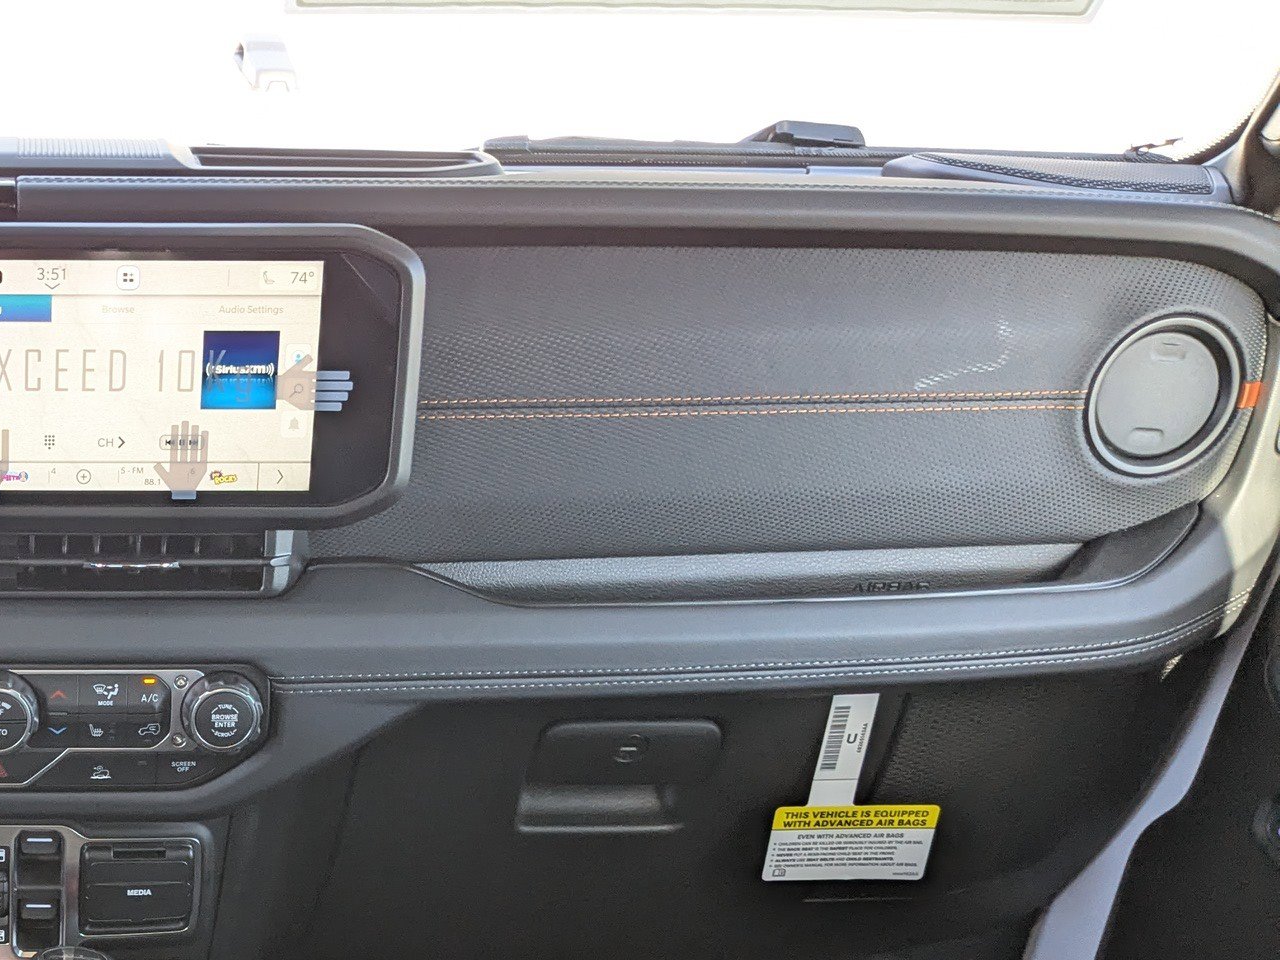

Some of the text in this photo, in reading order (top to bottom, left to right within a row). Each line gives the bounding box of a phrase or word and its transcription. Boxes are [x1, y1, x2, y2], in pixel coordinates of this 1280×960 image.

[36, 267, 67, 281] 3:51
[290, 271, 315, 284] 74°
[102, 305, 135, 314] Browse
[218, 305, 284, 316] Audio Settings
[97, 438, 114, 447] CH
[144, 478, 161, 486] 88.1
[141, 693, 159, 703] A/C
[211, 713, 238, 721] BROWSE
[846, 733, 858, 744] U
[785, 811, 809, 819] THIS
[812, 811, 858, 819] VEHICLE
[874, 810, 930, 818] EQUIPPED
[783, 820, 811, 828] WITH
[813, 819, 874, 827] ADVANCED
[875, 819, 895, 827] AIR
